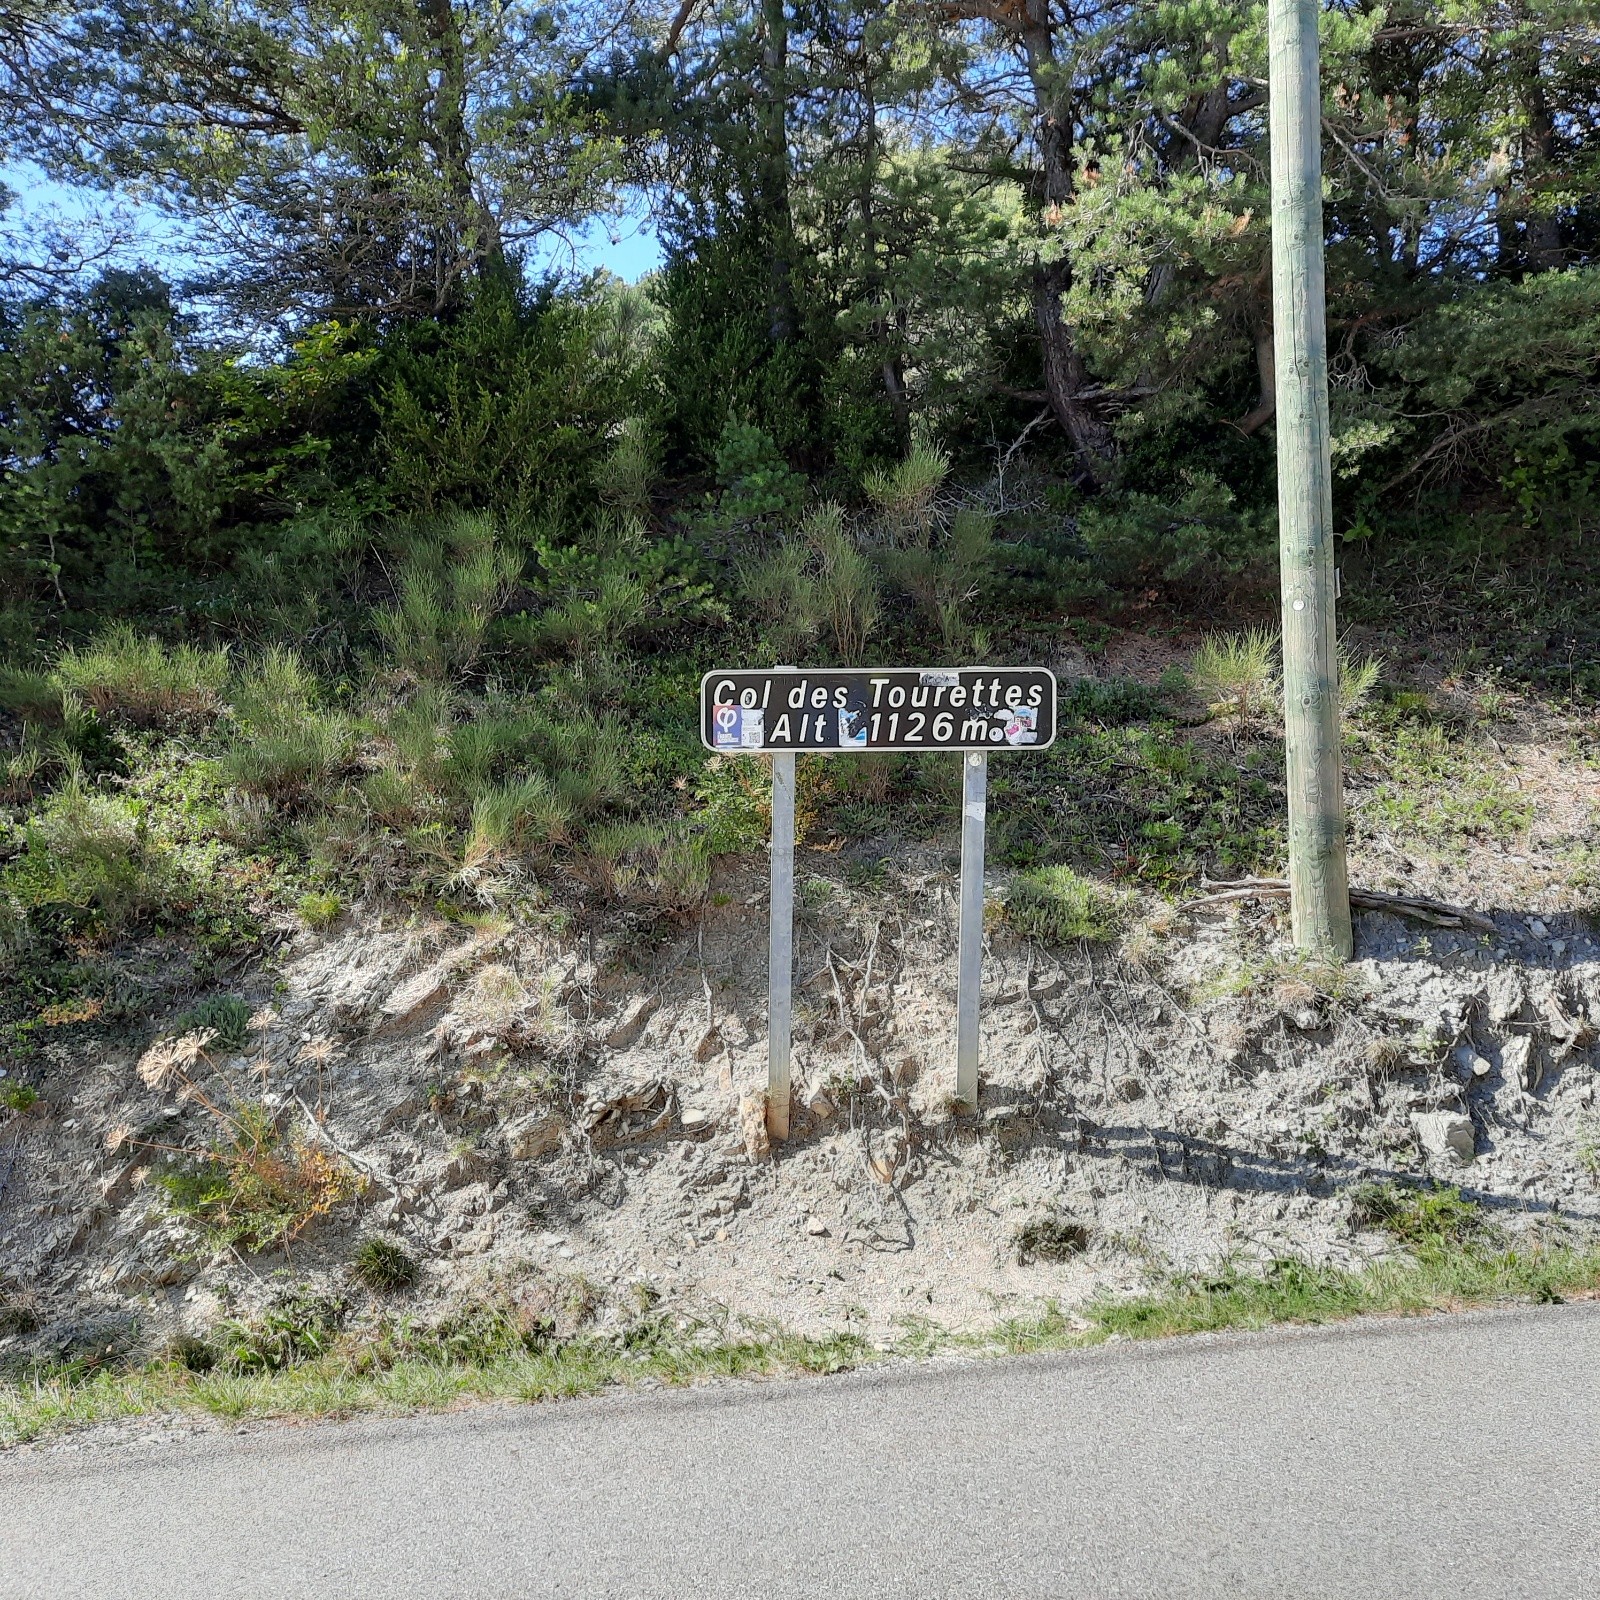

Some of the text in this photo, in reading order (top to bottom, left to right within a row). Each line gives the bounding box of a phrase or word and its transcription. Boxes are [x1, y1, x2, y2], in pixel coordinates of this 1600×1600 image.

[714, 680, 771, 708] Col
[788, 680, 848, 708] des
[870, 677, 1043, 708] Tourettes
[769, 714, 827, 743] Alt
[870, 712, 954, 742] 1126
